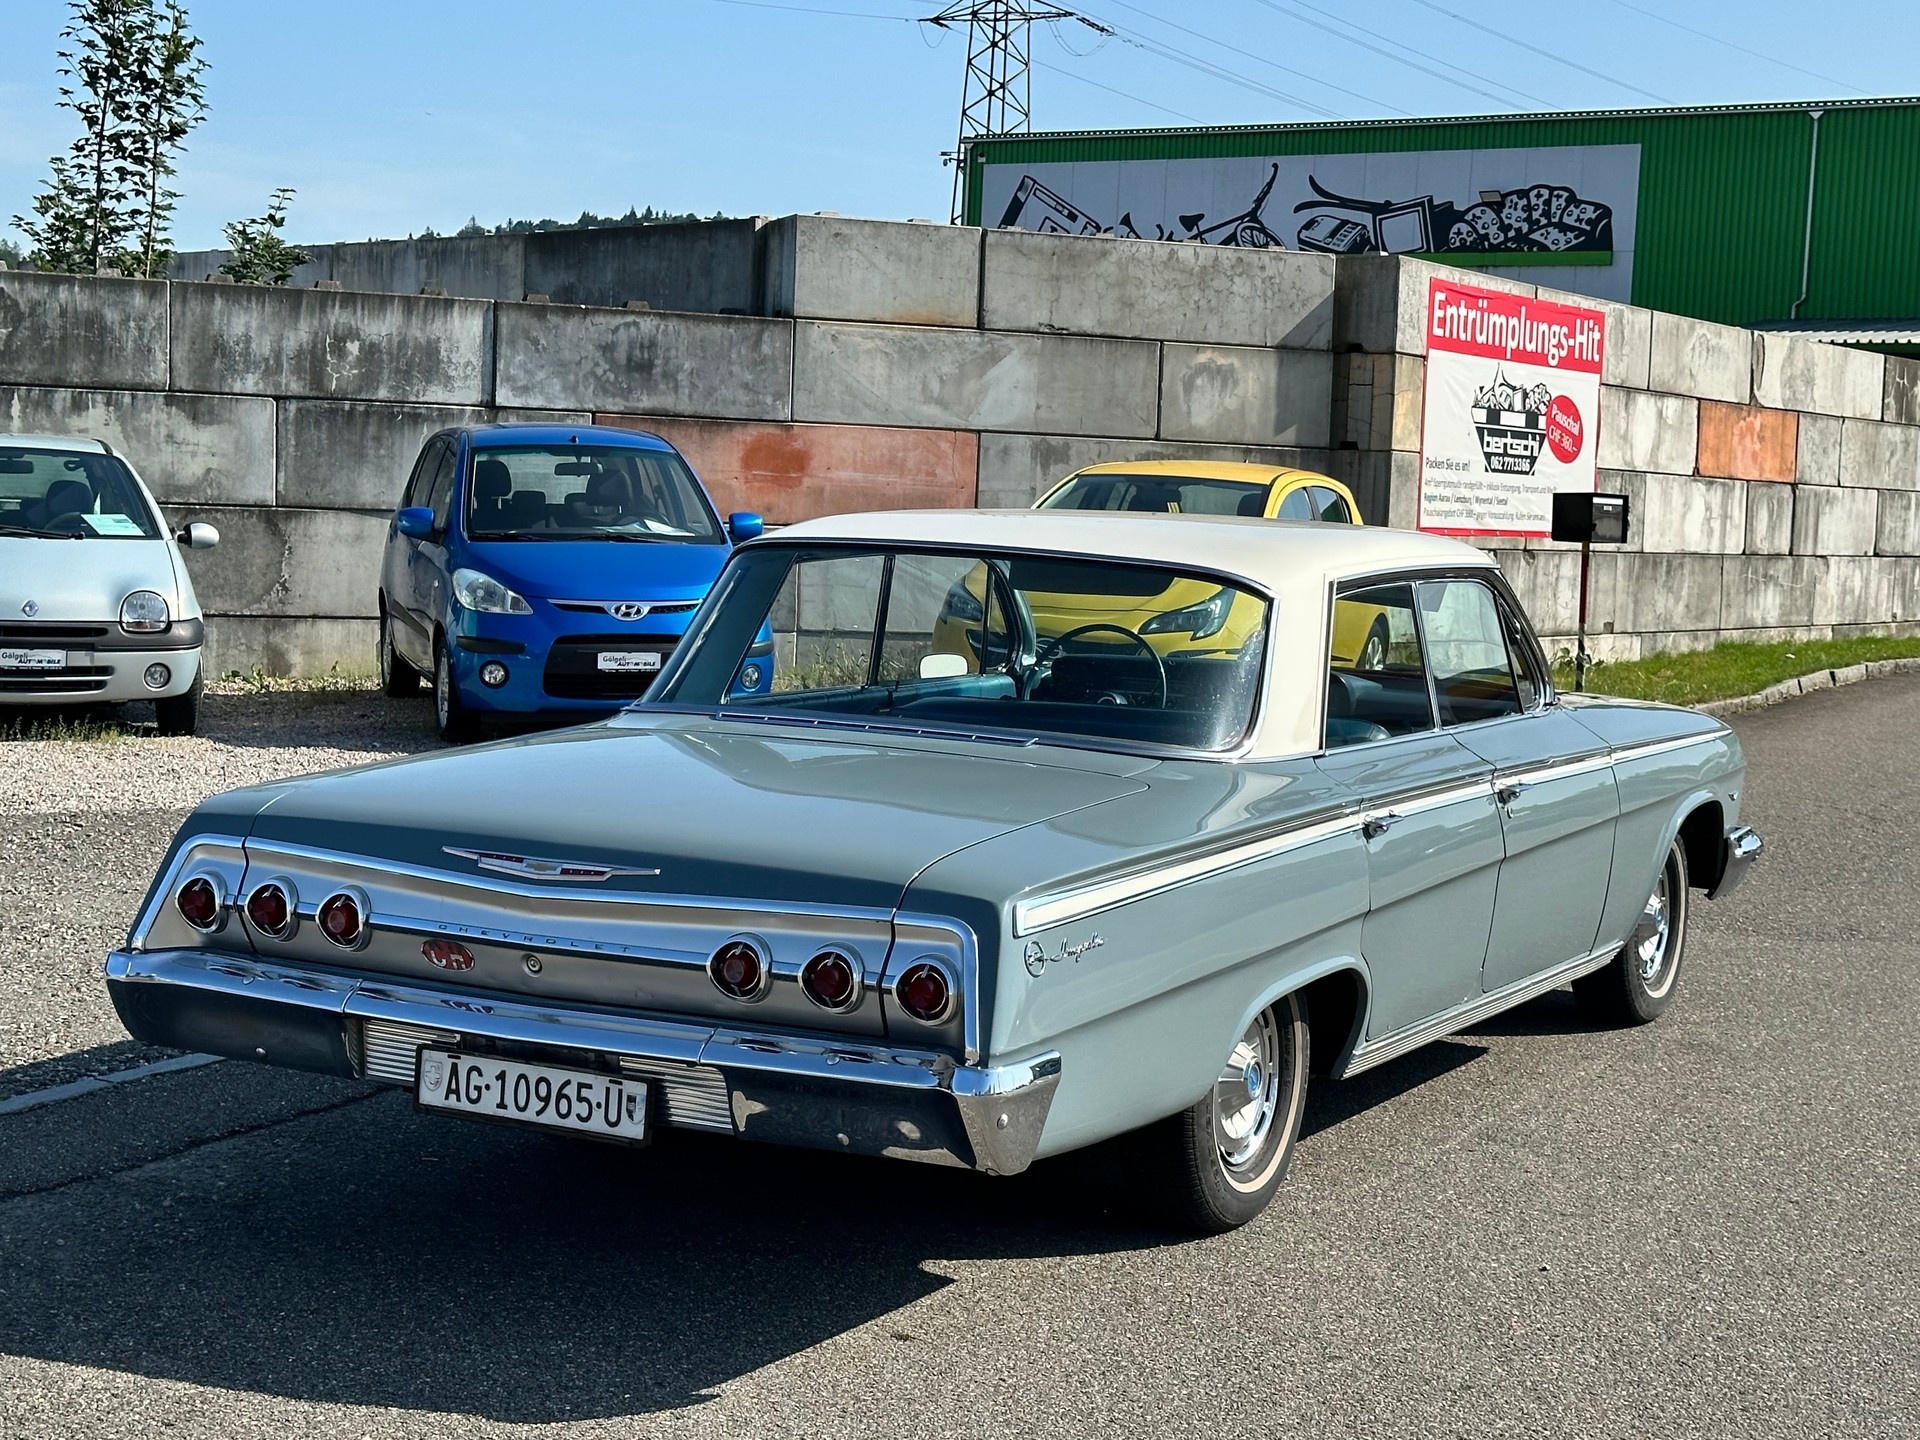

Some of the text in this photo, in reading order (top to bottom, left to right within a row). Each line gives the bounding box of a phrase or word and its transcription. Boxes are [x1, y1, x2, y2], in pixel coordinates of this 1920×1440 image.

[1432, 291, 1601, 367] Entrümplungs-Hit
[1548, 425, 1561, 444] CHF
[1551, 404, 1580, 437] Pauschal
[1483, 429, 1540, 457] bertschi
[1425, 456, 1445, 470] Packen
[1445, 458, 1454, 471] Sie
[1, 651, 28, 661] Gölgeli
[438, 924, 632, 953] CHEVROLET
